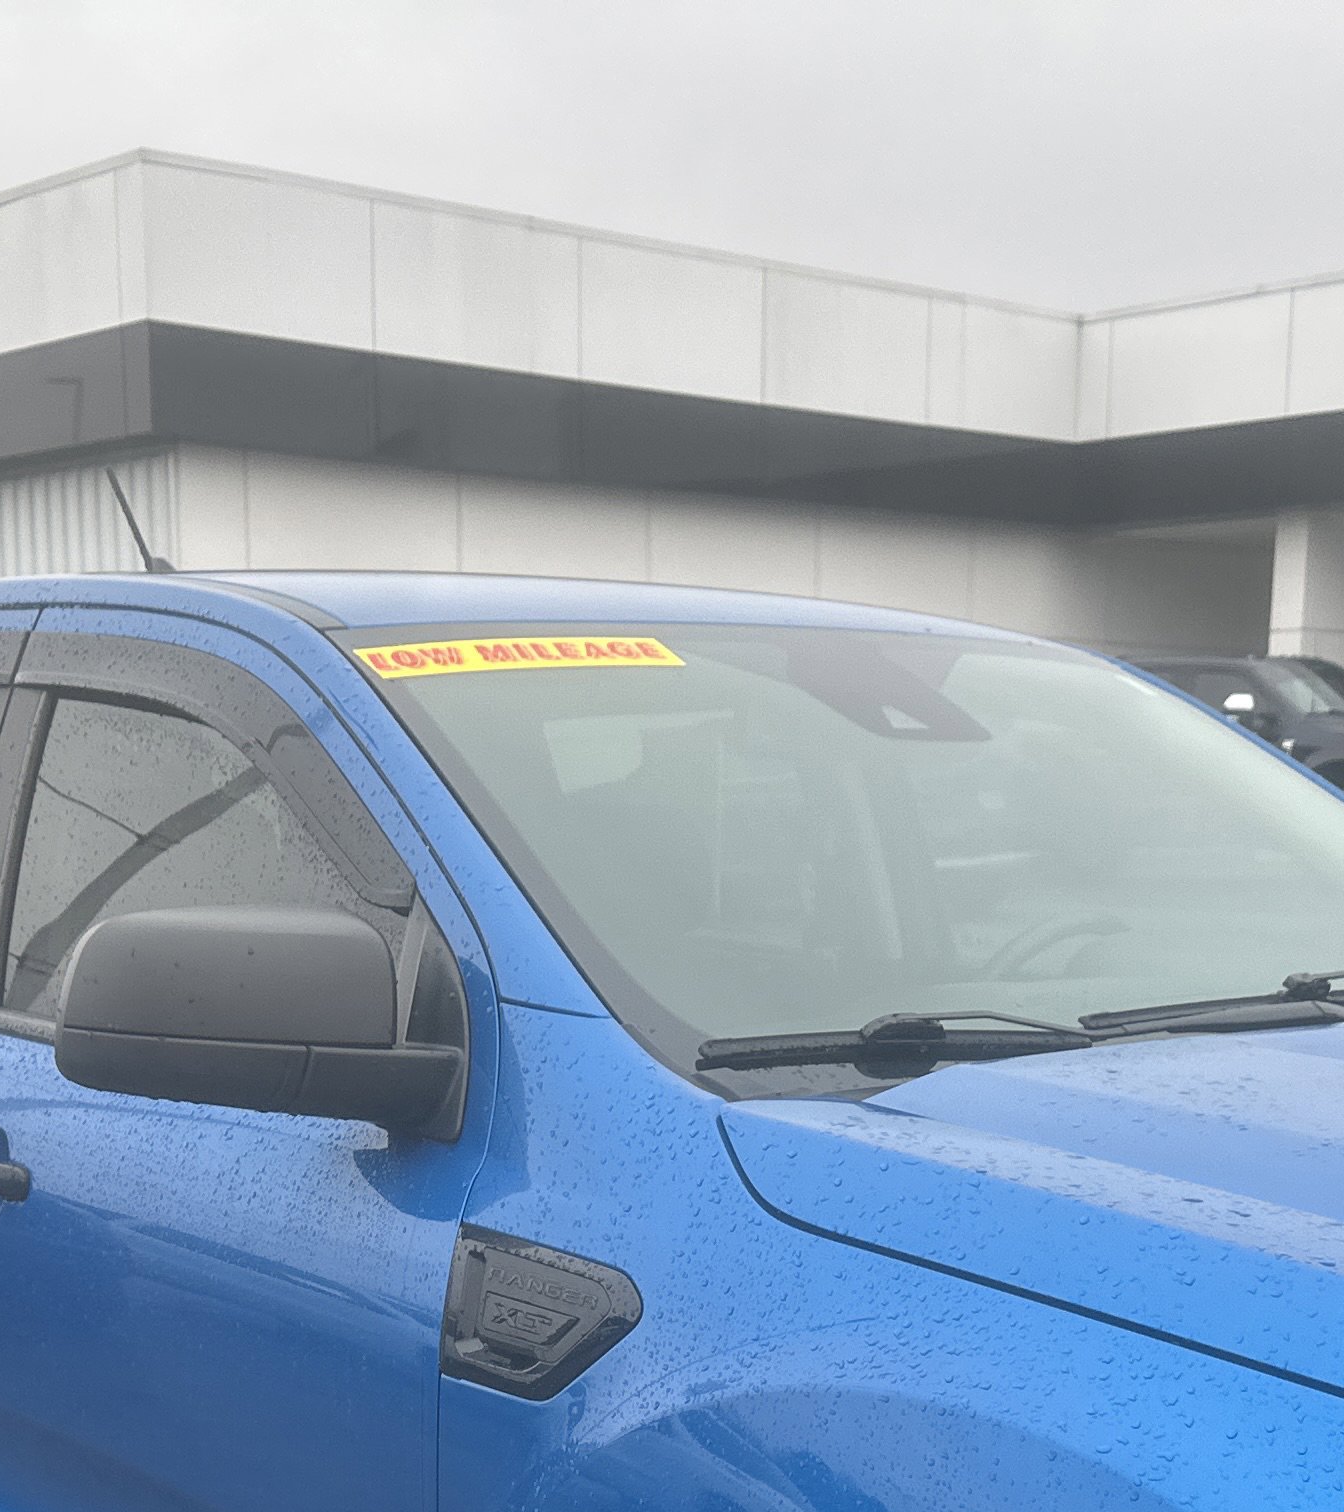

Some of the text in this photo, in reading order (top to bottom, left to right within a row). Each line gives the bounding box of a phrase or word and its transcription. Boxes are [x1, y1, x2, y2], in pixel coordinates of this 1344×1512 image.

[366, 640, 668, 672] LOW MILEAGE
[487, 1266, 599, 1310] RANGER
